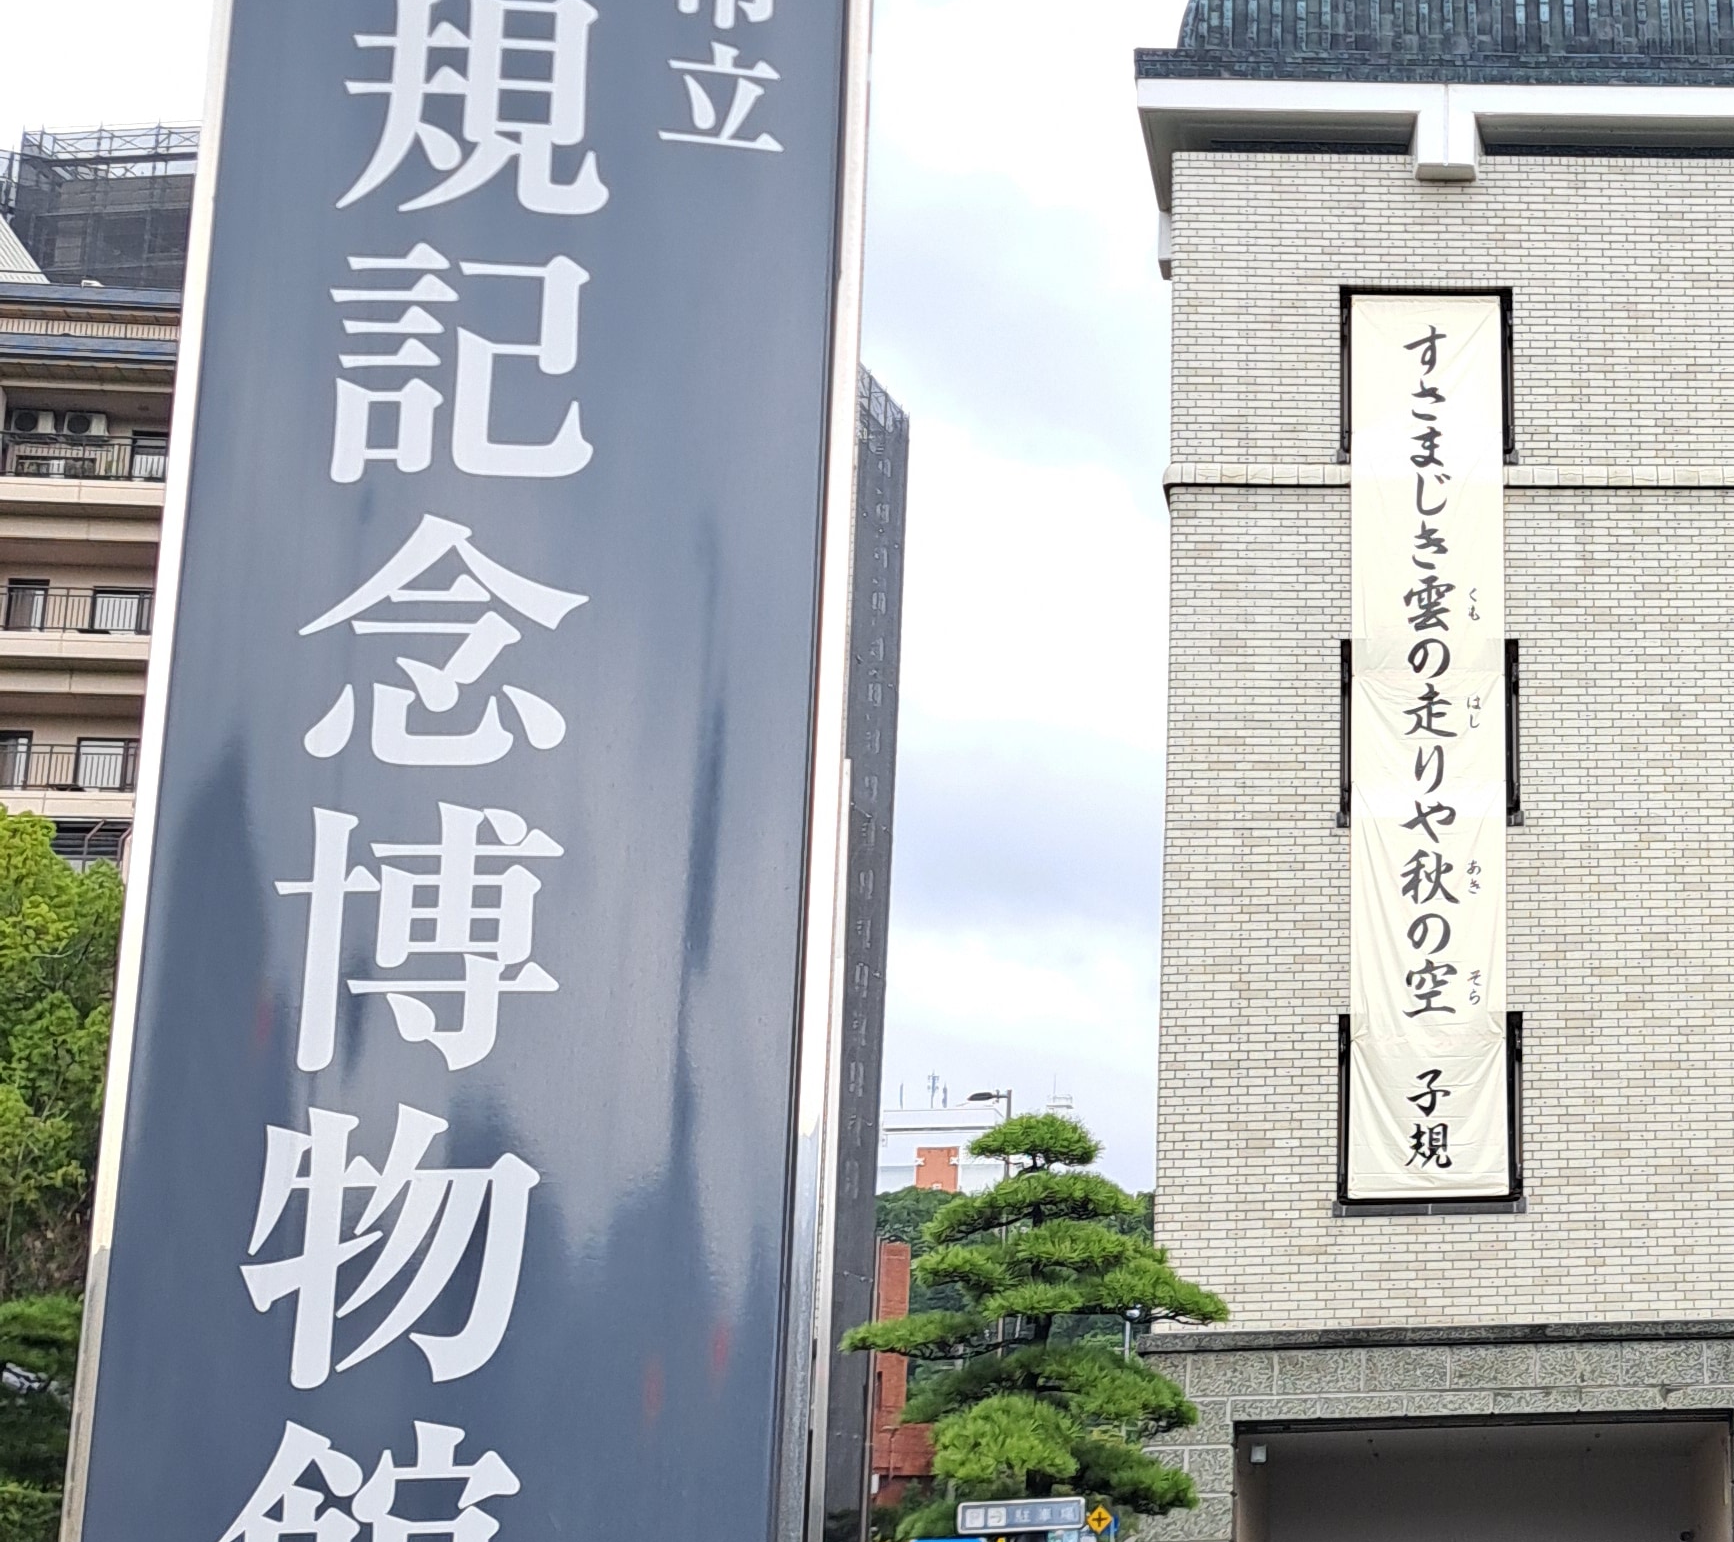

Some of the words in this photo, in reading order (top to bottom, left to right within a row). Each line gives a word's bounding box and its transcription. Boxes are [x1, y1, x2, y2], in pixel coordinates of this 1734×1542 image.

[1402, 324, 1460, 1016] すさまじき雲の走りや秋の空
[1467, 696, 1482, 729] はし
[1466, 859, 1482, 895] あき
[1467, 970, 1482, 1005] そら
[1405, 1068, 1453, 1169] 子規
